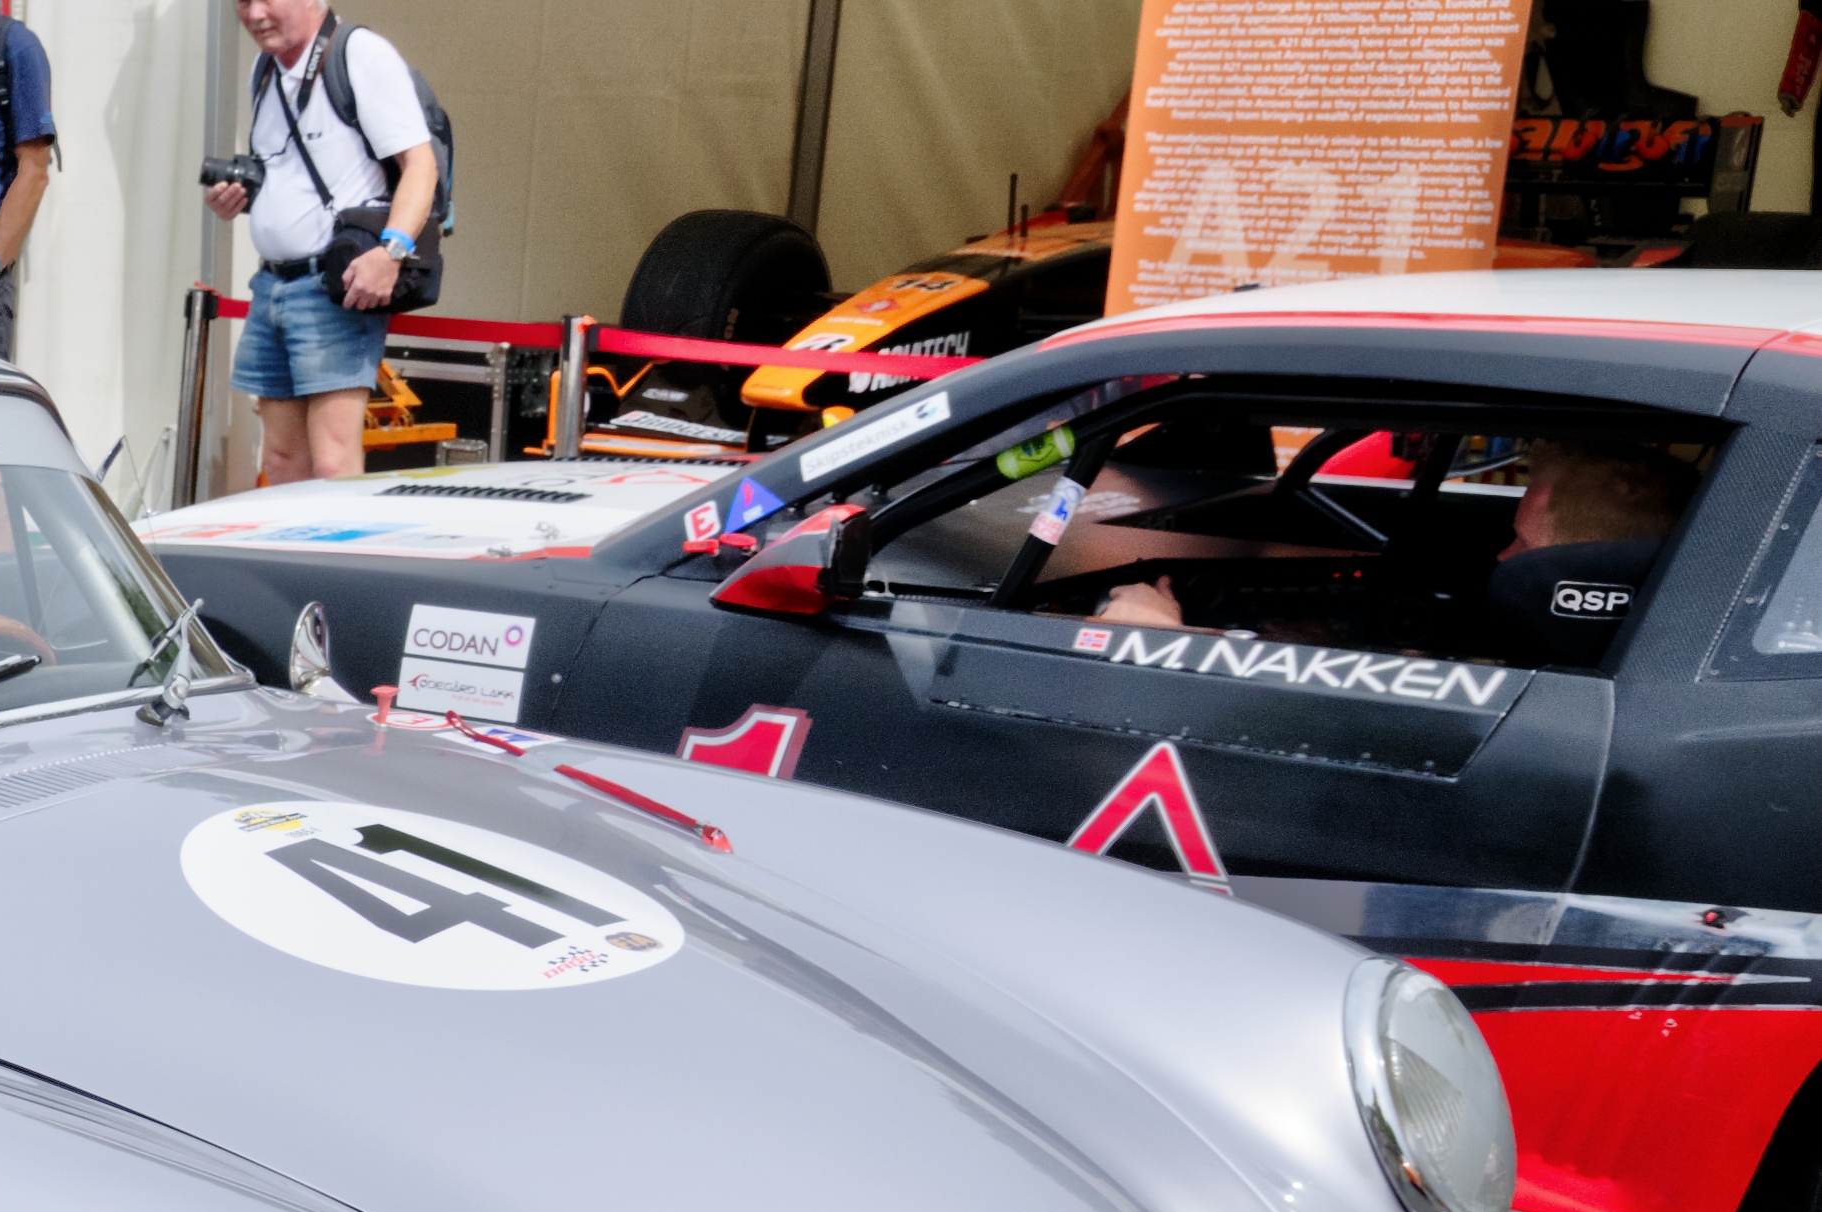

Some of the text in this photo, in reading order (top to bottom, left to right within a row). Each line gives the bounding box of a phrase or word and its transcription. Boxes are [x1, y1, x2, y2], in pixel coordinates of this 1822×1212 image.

[805, 416, 911, 474] Skipsteknisk
[1556, 586, 1630, 615] QSP
[413, 628, 499, 657] CODAN
[1196, 638, 1507, 706] NAKKEN
[265, 823, 629, 949] 41
